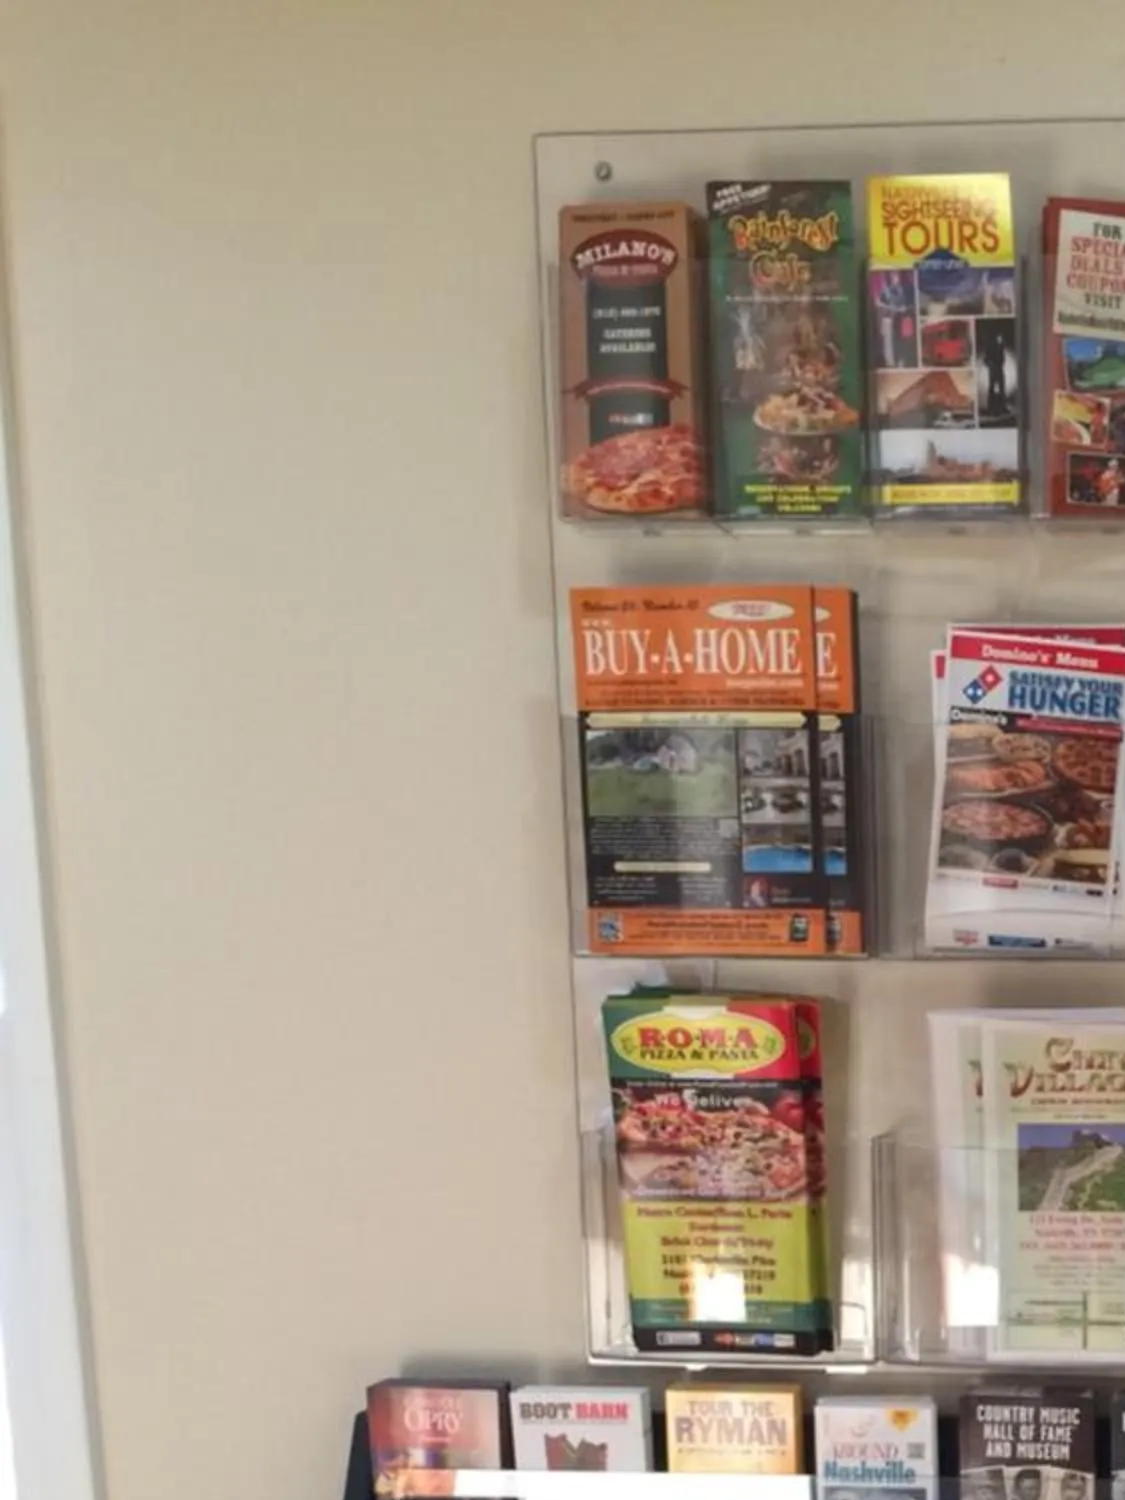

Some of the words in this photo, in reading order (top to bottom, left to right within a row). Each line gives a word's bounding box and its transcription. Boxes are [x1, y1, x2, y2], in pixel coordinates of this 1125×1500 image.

[882, 219, 999, 257] TOURS
[1093, 222, 1123, 240] FOR
[575, 240, 676, 270] MILANO'S
[1070, 254, 1124, 277] DEALS
[1083, 293, 1122, 311] VISIT
[981, 644, 1052, 664] Domino's
[1056, 652, 1099, 669] Menu
[1009, 670, 1072, 691] SATISFY
[1077, 678, 1124, 694] YOUR
[1008, 686, 1120, 718] HUNGER
[640, 1050, 688, 1061] PIZZA
[709, 1050, 759, 1061] PASTA
[519, 1401, 573, 1421] BOOT
[575, 1402, 628, 1421] BARN
[687, 1400, 735, 1417] TOUR
[740, 1401, 776, 1417] THE
[976, 1404, 1035, 1424] COUNTRY
[1039, 1406, 1081, 1425] MUSIC
[675, 1416, 787, 1446] RYMAN
[983, 1424, 1014, 1441] HALL
[1018, 1425, 1035, 1441] OF
[1039, 1425, 1073, 1443] FAME
[985, 1442, 1012, 1459] AND
[1016, 1443, 1070, 1461] MUSEUM
[823, 1460, 917, 1485] Nashville
